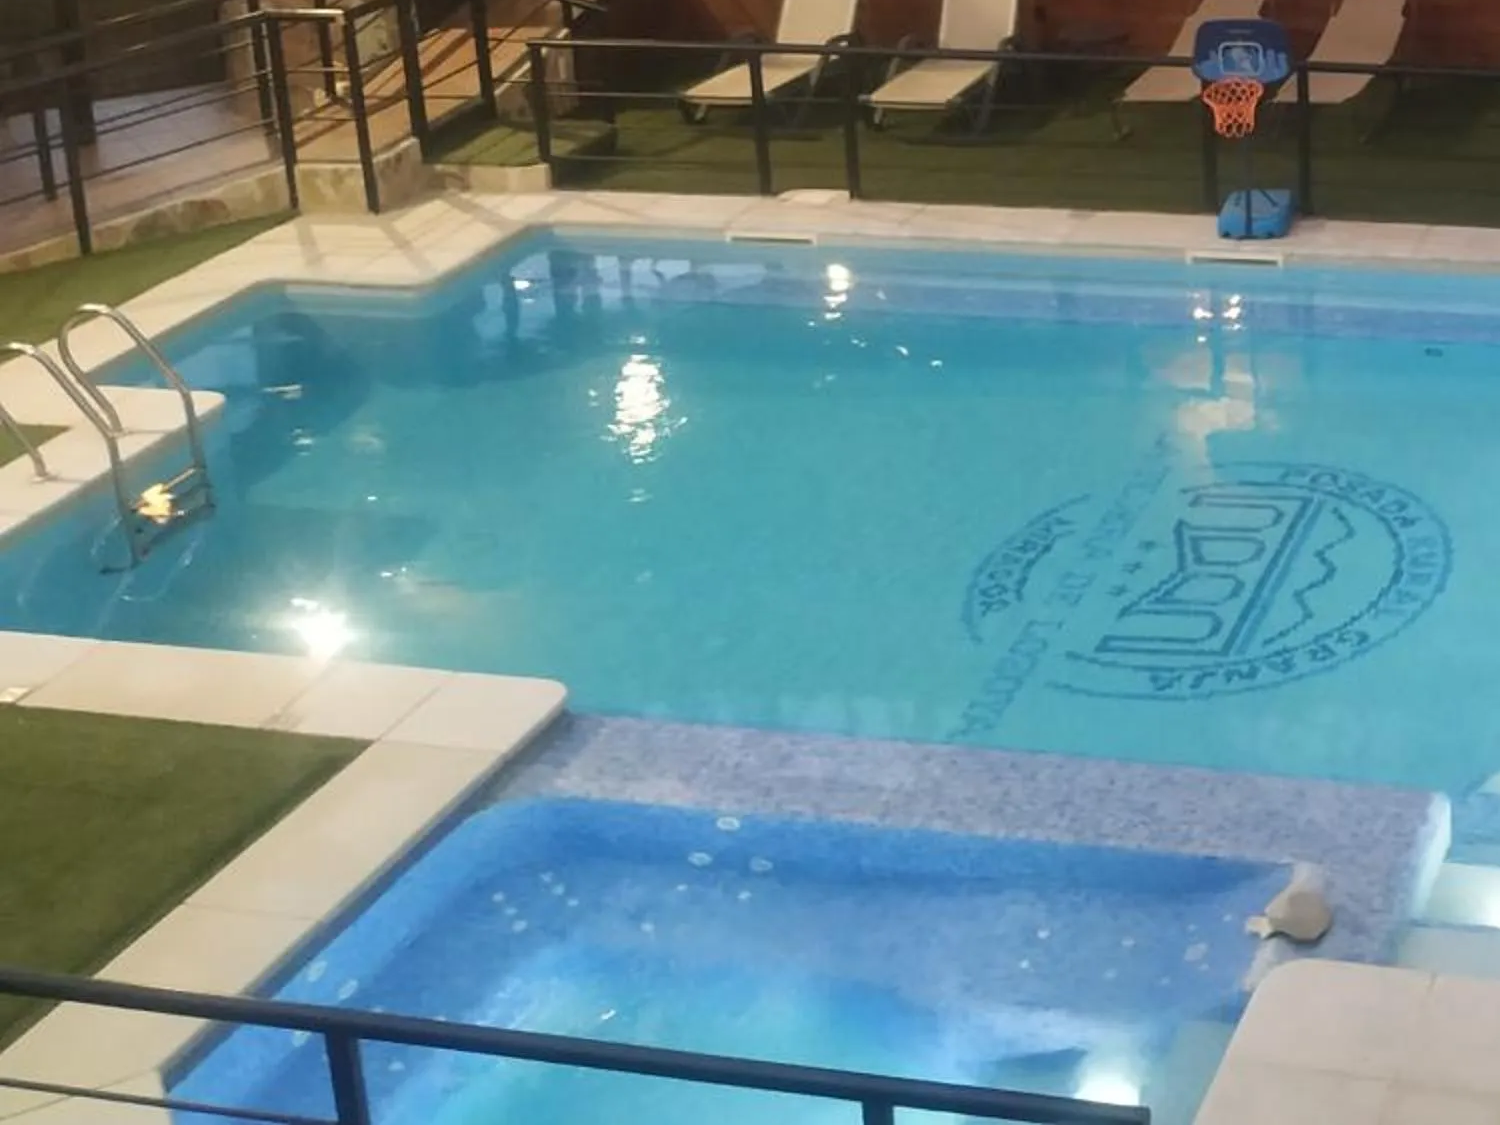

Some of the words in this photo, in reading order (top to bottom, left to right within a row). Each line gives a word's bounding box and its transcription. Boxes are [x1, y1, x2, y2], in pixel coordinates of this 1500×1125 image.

[1279, 466, 1422, 528] POSADA
[978, 516, 1076, 617] MIRADOR
[1375, 534, 1438, 616] RURAL
[1149, 630, 1370, 691] GRANJA
